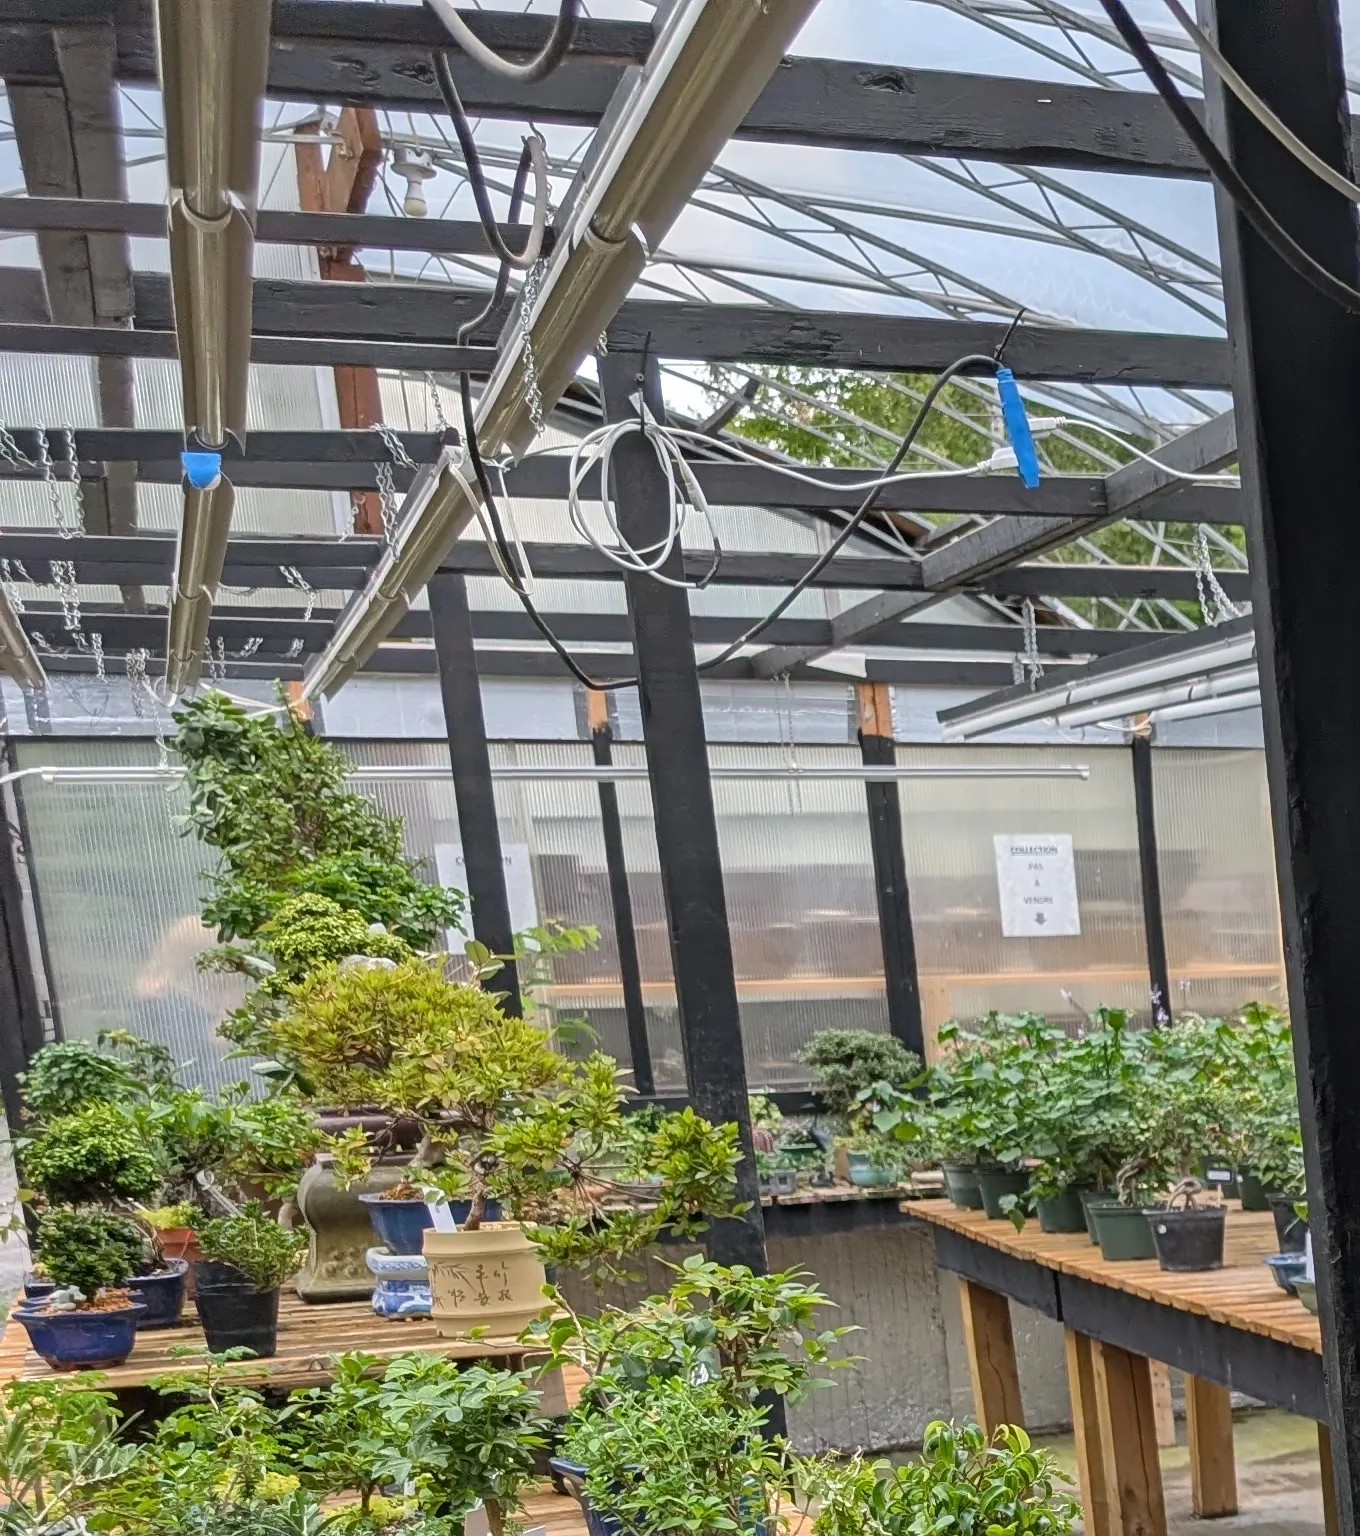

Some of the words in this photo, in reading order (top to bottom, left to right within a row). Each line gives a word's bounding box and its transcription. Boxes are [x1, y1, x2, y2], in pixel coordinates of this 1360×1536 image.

[1010, 845, 1058, 856] COLLECTION
[1027, 862, 1043, 871] PAS
[1023, 895, 1053, 904] VENDRE
